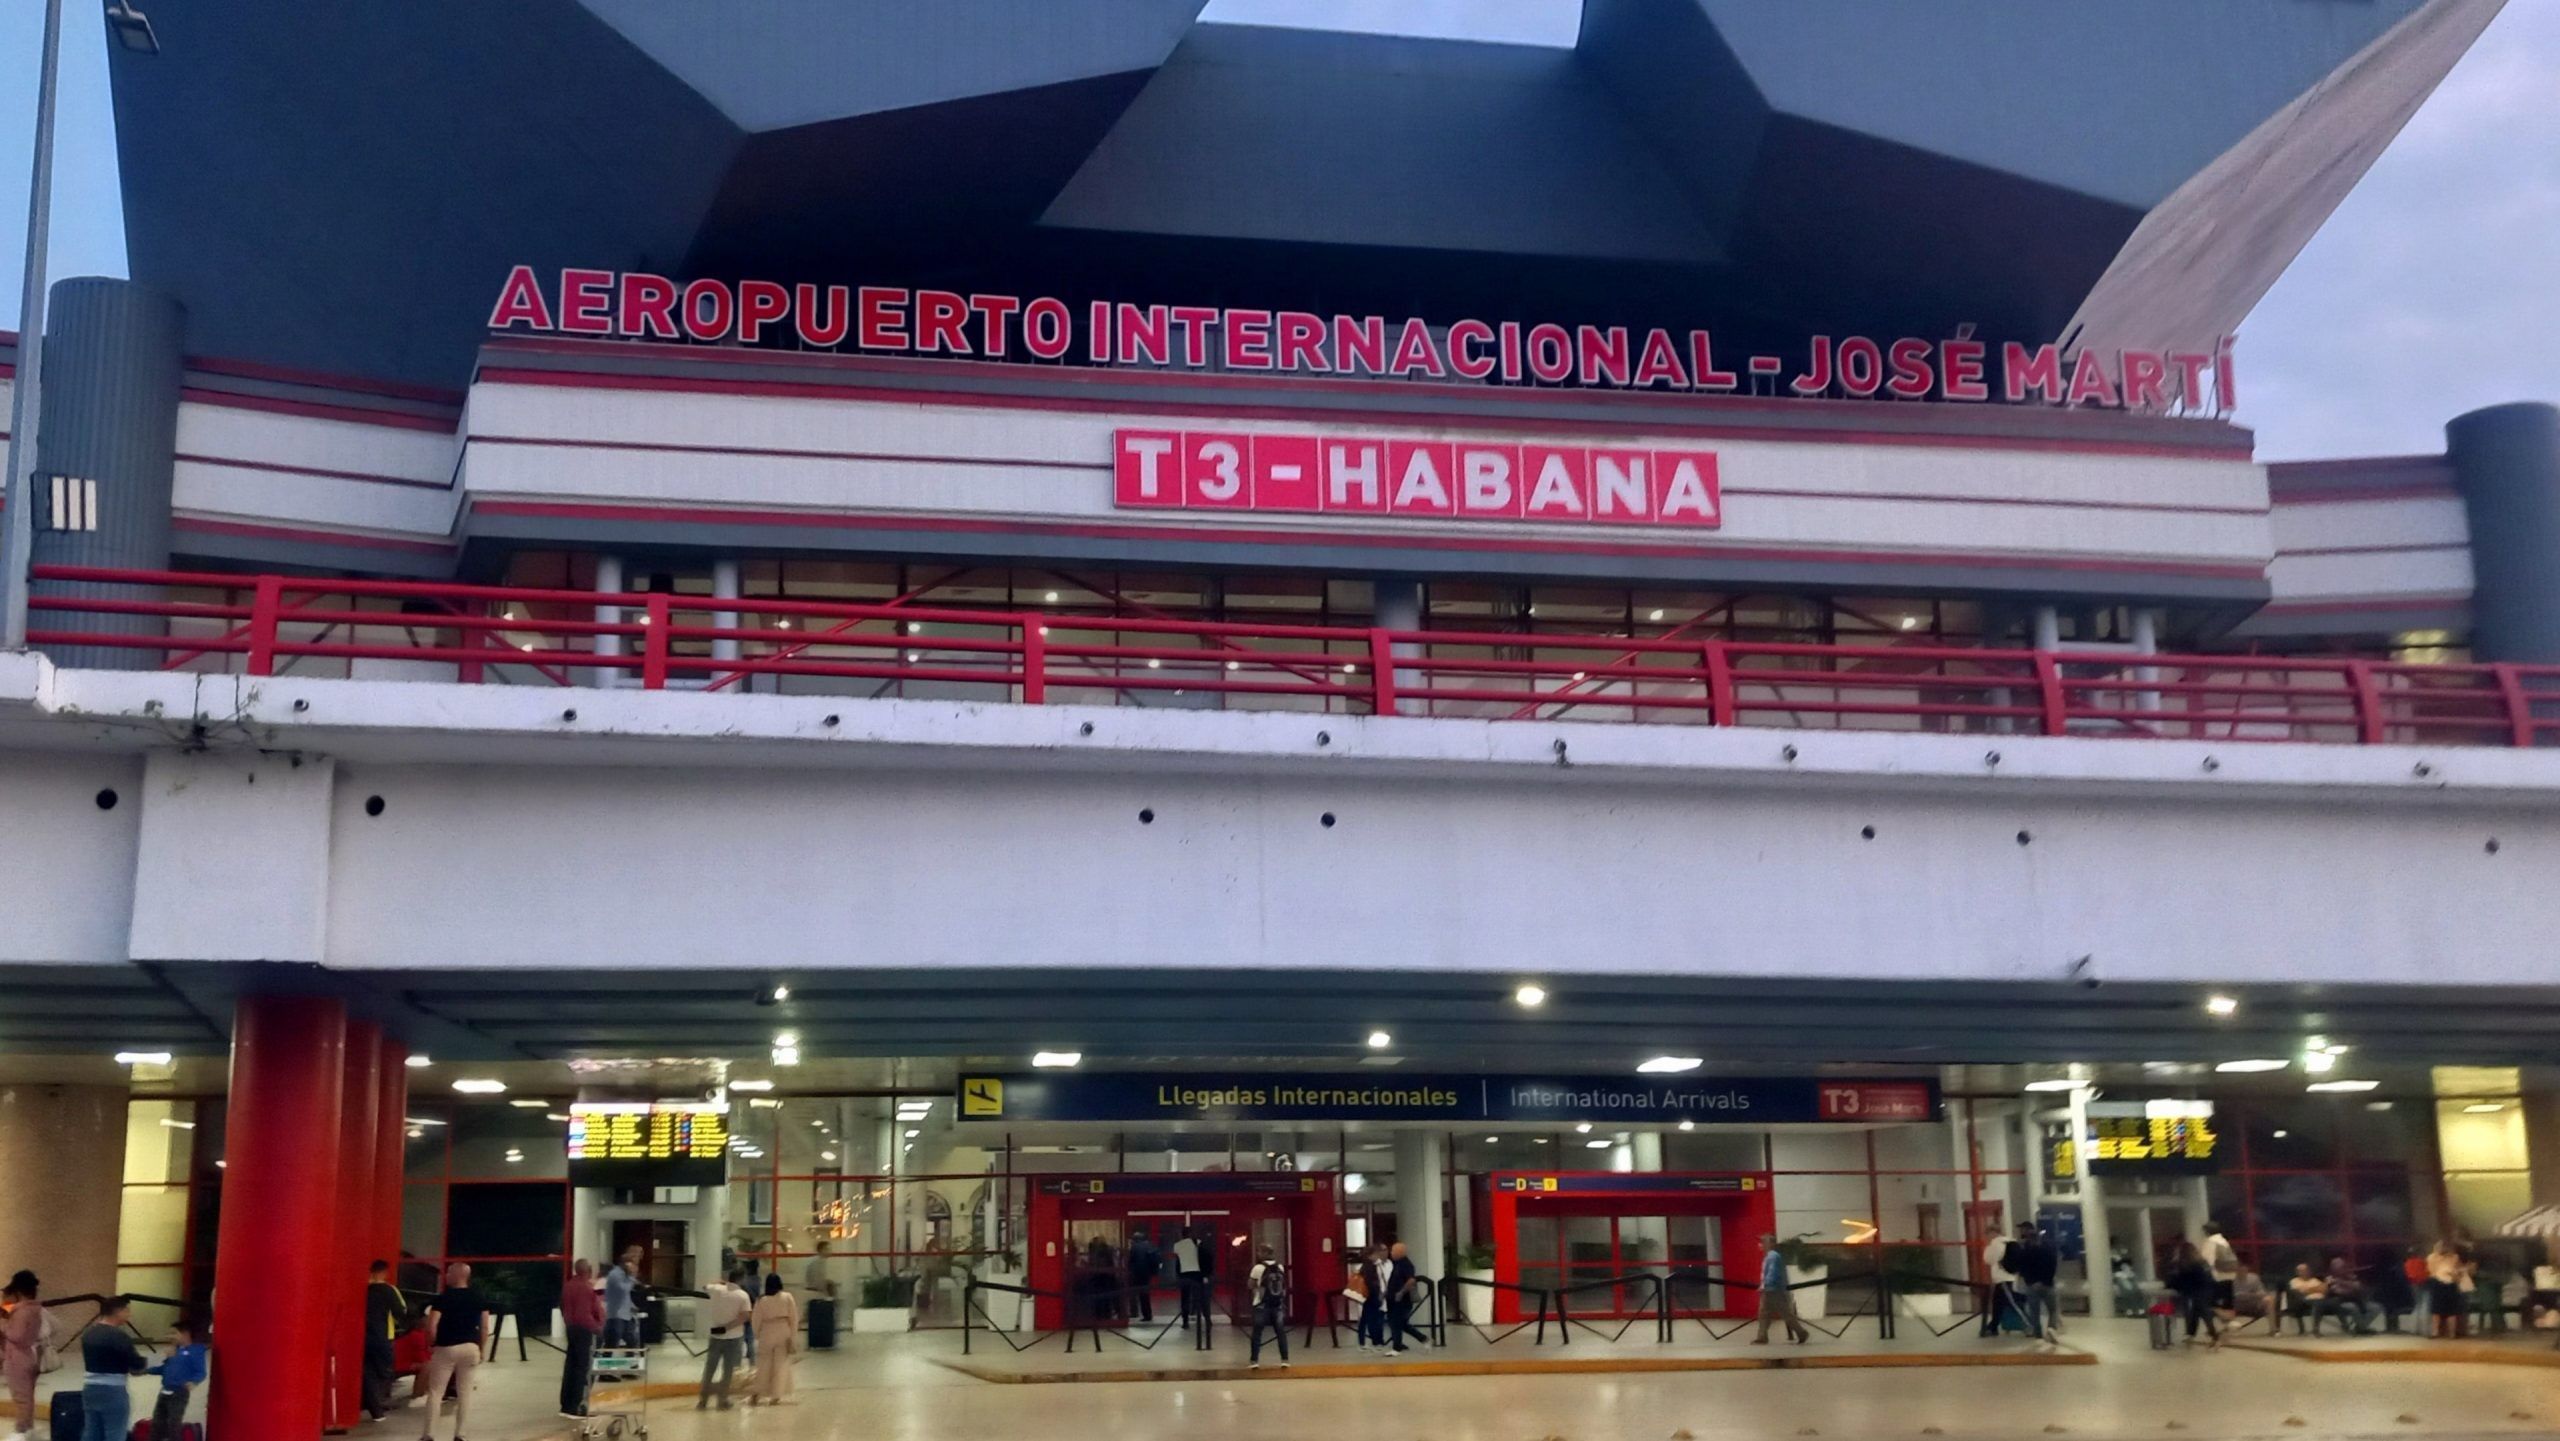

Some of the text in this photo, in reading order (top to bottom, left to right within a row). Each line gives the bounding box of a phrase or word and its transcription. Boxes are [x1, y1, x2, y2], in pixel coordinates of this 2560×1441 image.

[488, 264, 1072, 358] AEROPUERTO
[1089, 300, 1738, 389] INTERNACIONAL
[1790, 322, 1989, 399] JOSÉ
[2002, 334, 2240, 412] MARTÍ
[1158, 1085, 1458, 1110] Llegadas Internacionales
[1511, 1087, 1751, 1110] International Arrivals
[1824, 1088, 1860, 1114] T3
